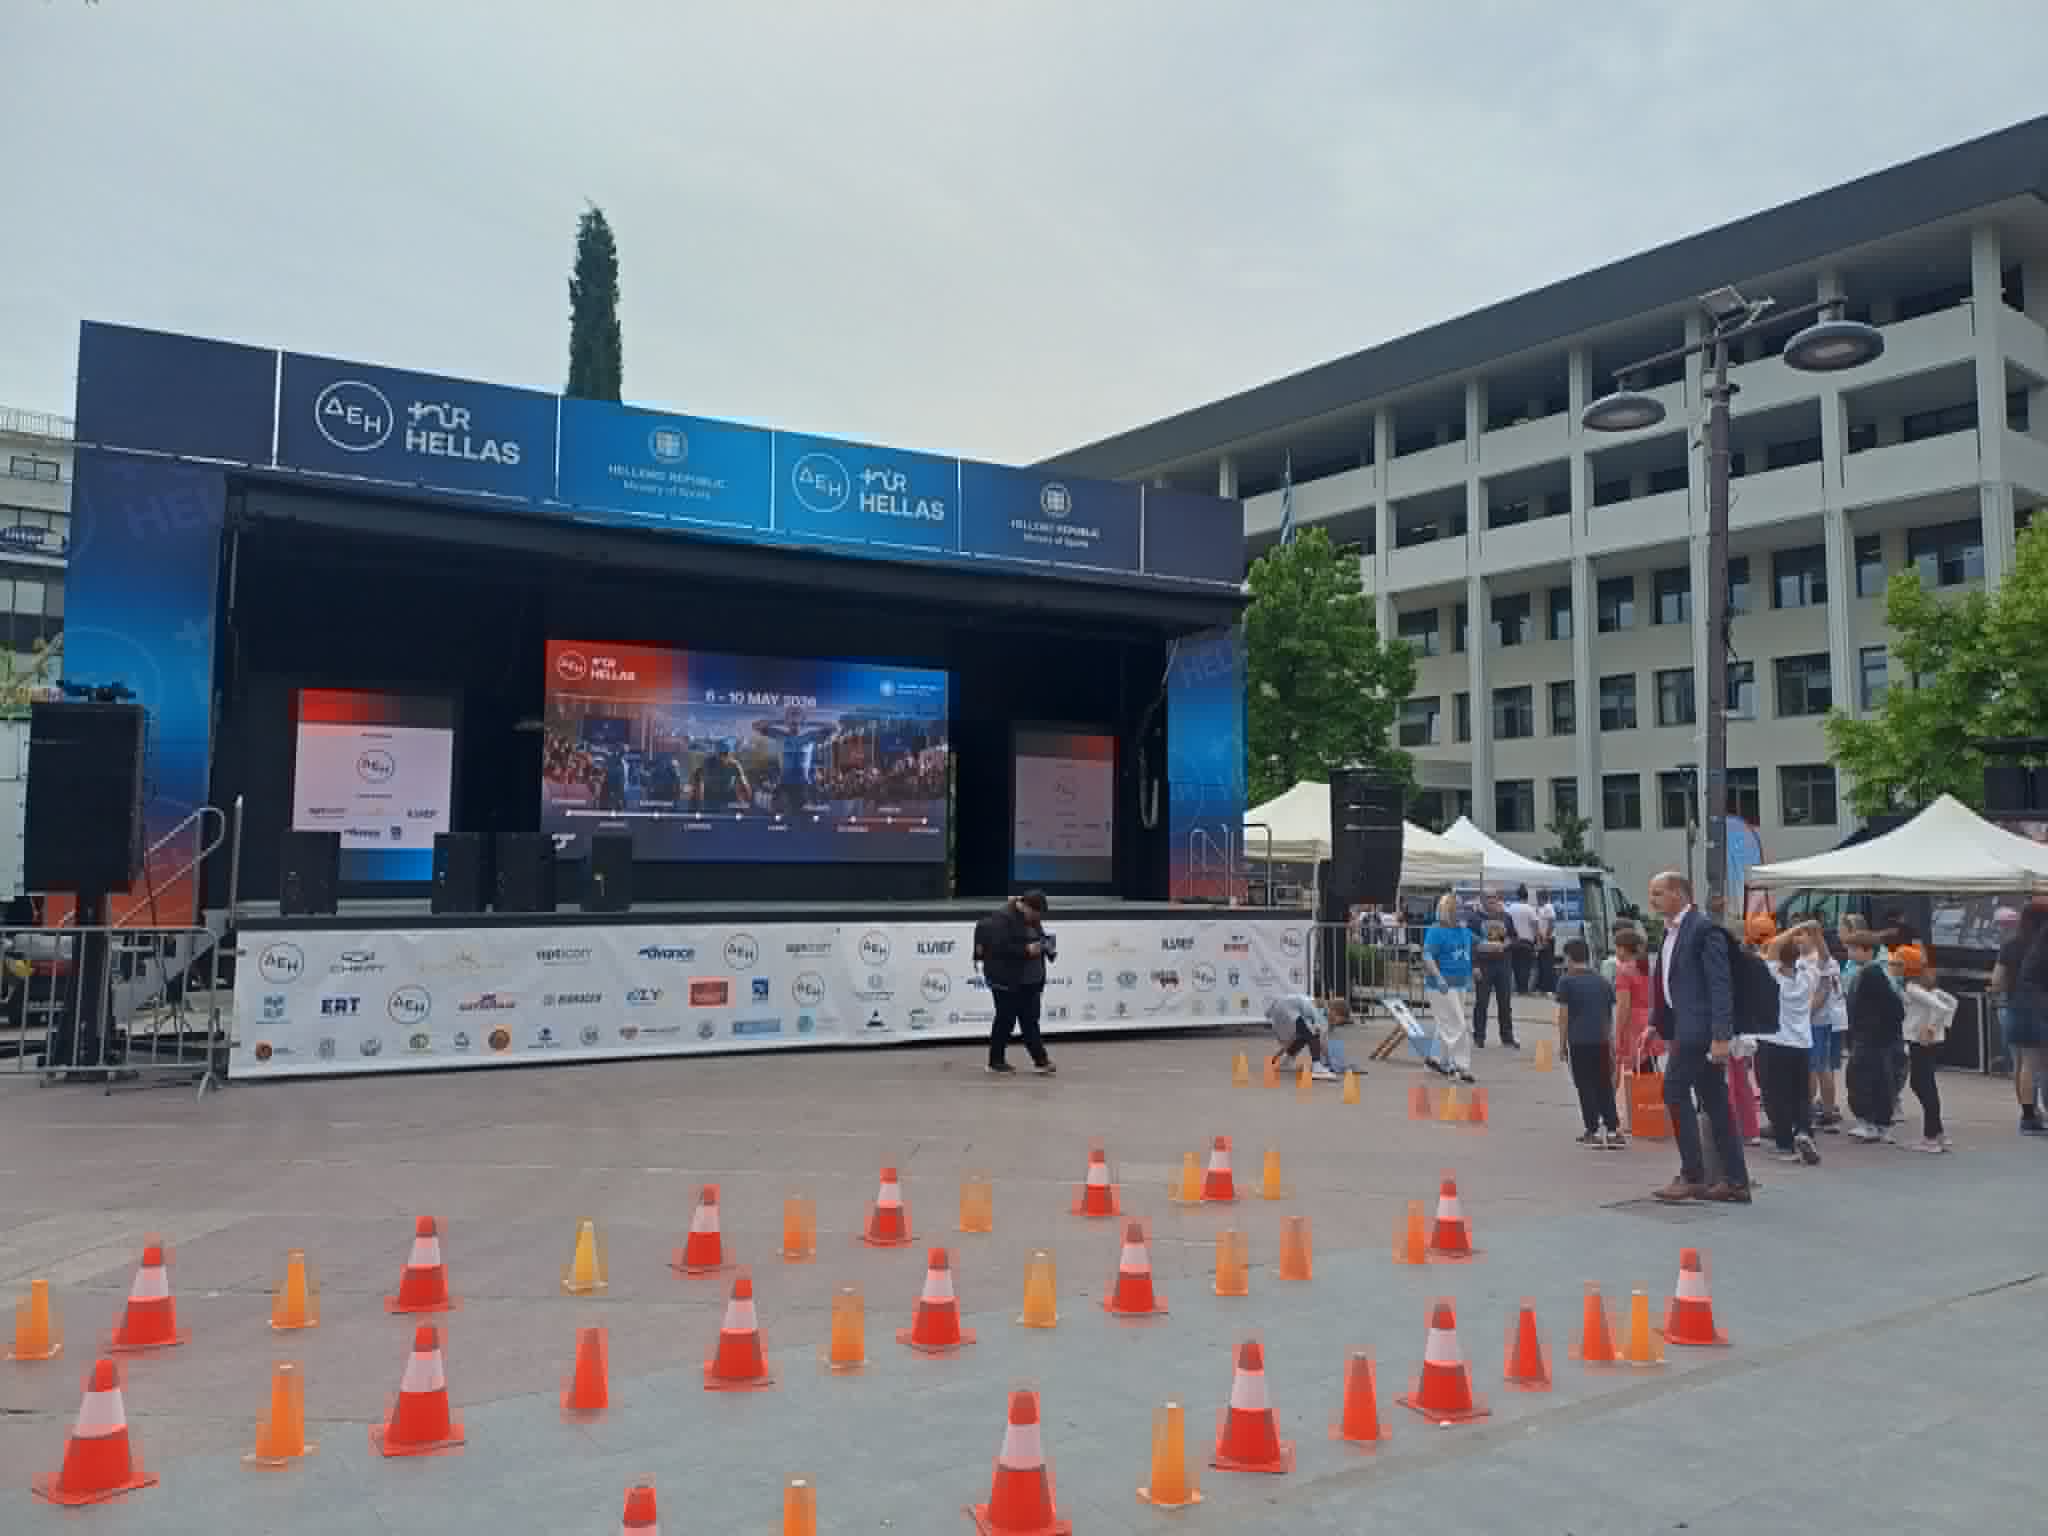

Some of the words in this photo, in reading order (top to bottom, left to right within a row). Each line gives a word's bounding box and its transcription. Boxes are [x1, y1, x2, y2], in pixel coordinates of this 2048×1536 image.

[405, 429, 520, 465] HELLAS
[858, 492, 945, 521] HELLAS
[321, 996, 361, 1016] ERT
